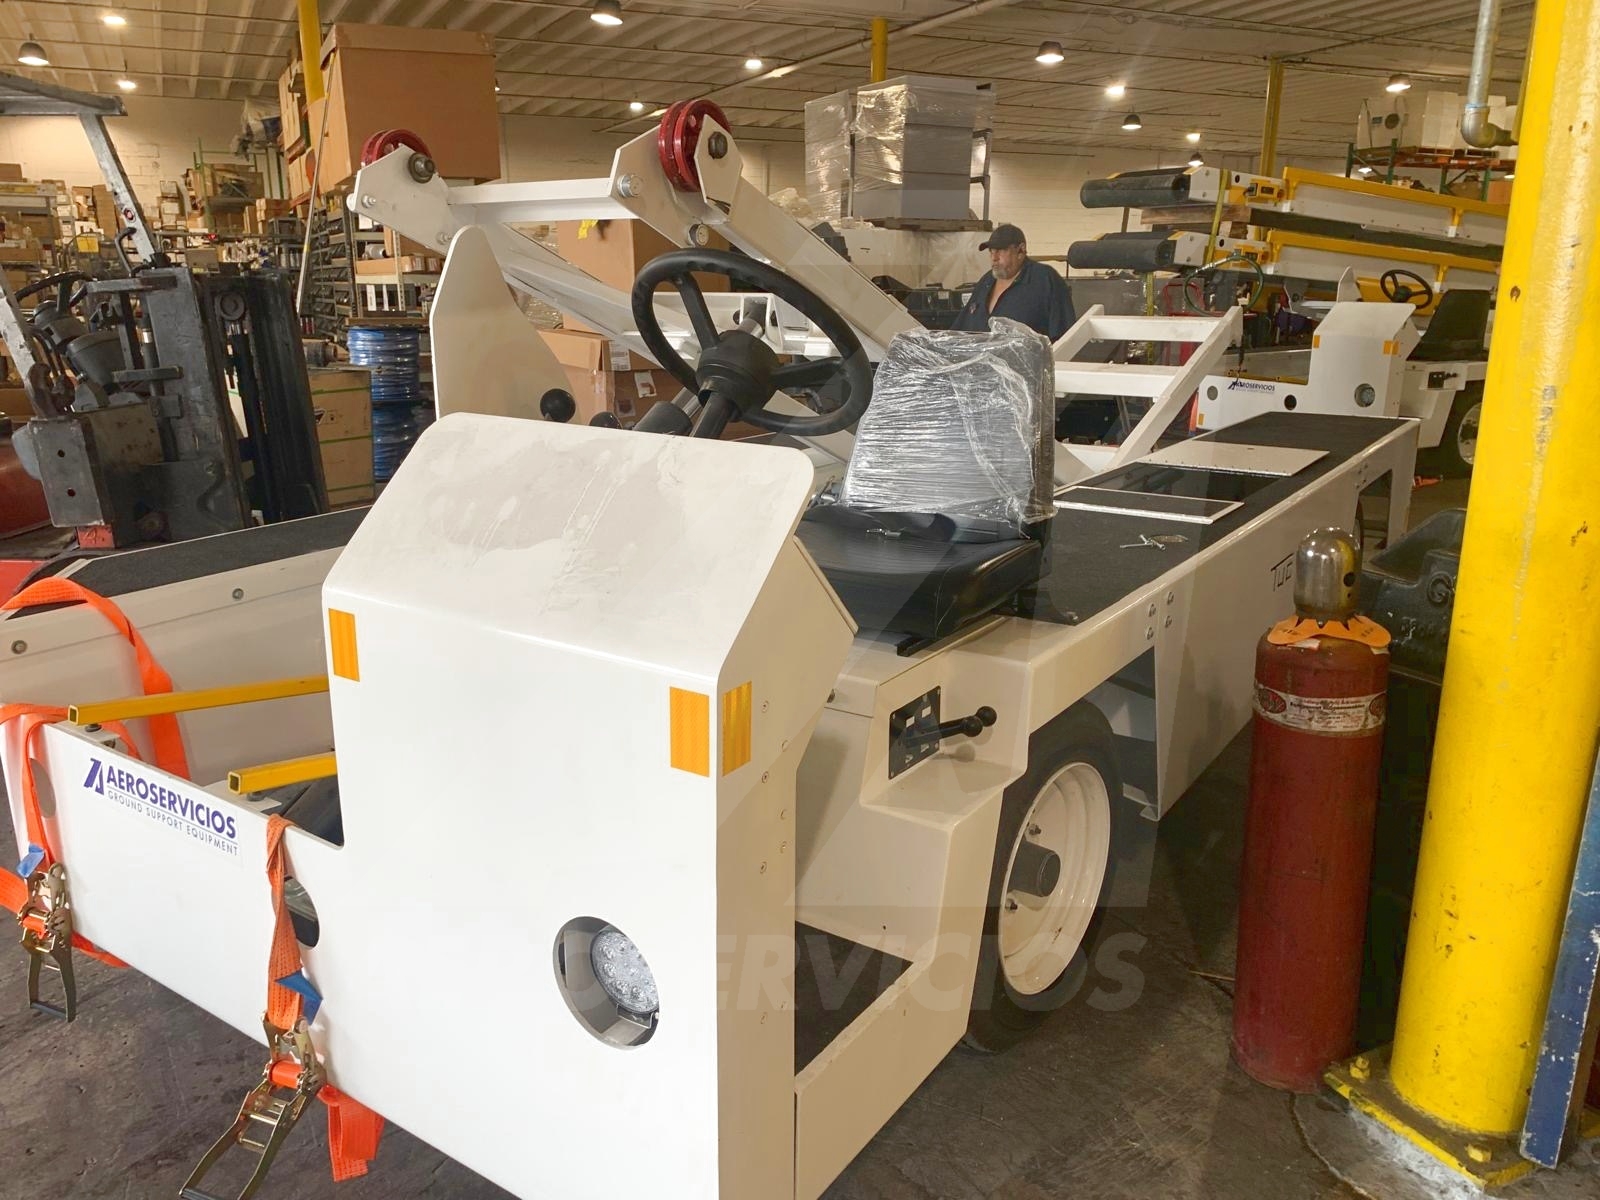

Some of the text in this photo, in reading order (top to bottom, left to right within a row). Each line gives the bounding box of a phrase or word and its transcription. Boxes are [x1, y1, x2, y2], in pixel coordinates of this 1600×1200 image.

[106, 765, 236, 840] AEROSERVICIOS
[108, 790, 238, 857] GROUND SUPPORT EQUIPMENT
